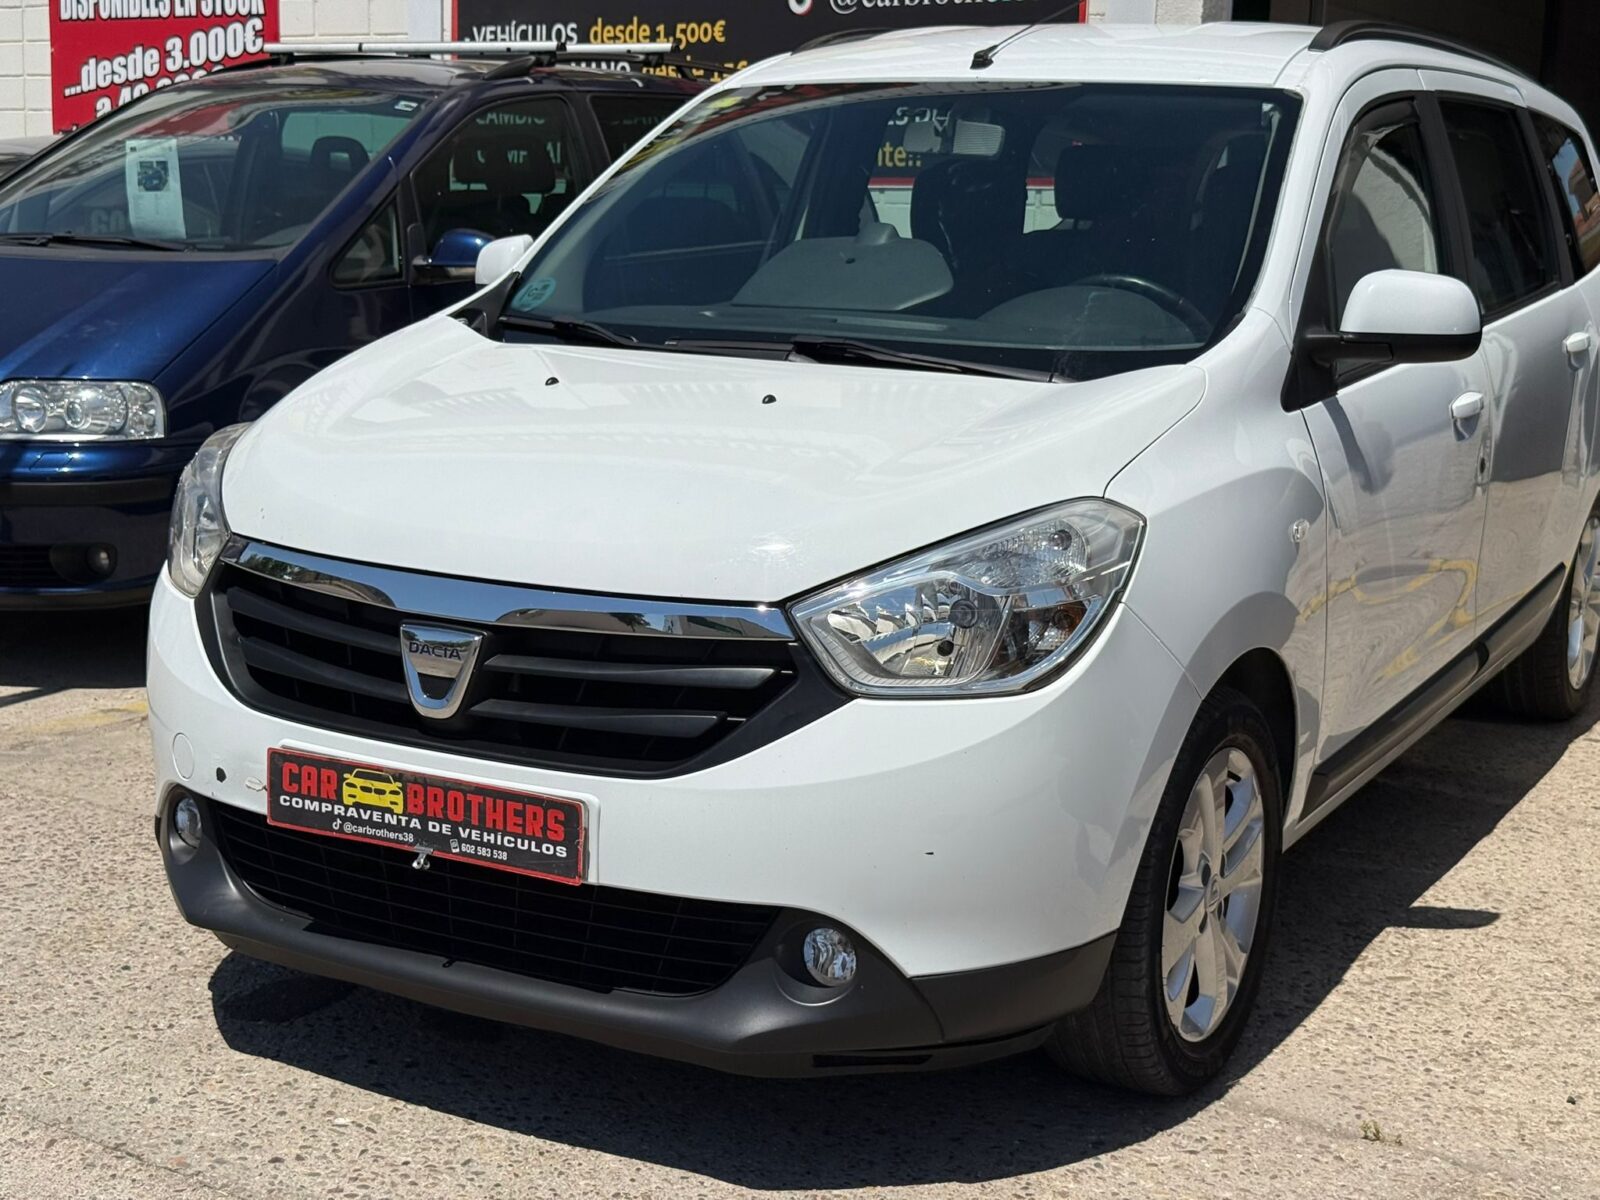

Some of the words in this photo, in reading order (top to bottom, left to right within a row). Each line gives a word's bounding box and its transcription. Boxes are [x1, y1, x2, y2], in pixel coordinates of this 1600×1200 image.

[589, 17, 650, 43] desde
[165, 17, 264, 72] 3.000€
[409, 642, 461, 660] DACIA
[282, 762, 338, 800] CAR
[407, 783, 565, 841] BROTHERS
[279, 795, 422, 829] COMPRAVENTA
[428, 821, 452, 835] DE
[458, 827, 568, 858] VEHÍCULOS
[343, 822, 414, 843] @carbrothers38
[461, 843, 476, 854] 602
[477, 847, 491, 858] 583
[493, 851, 508, 861] 538
